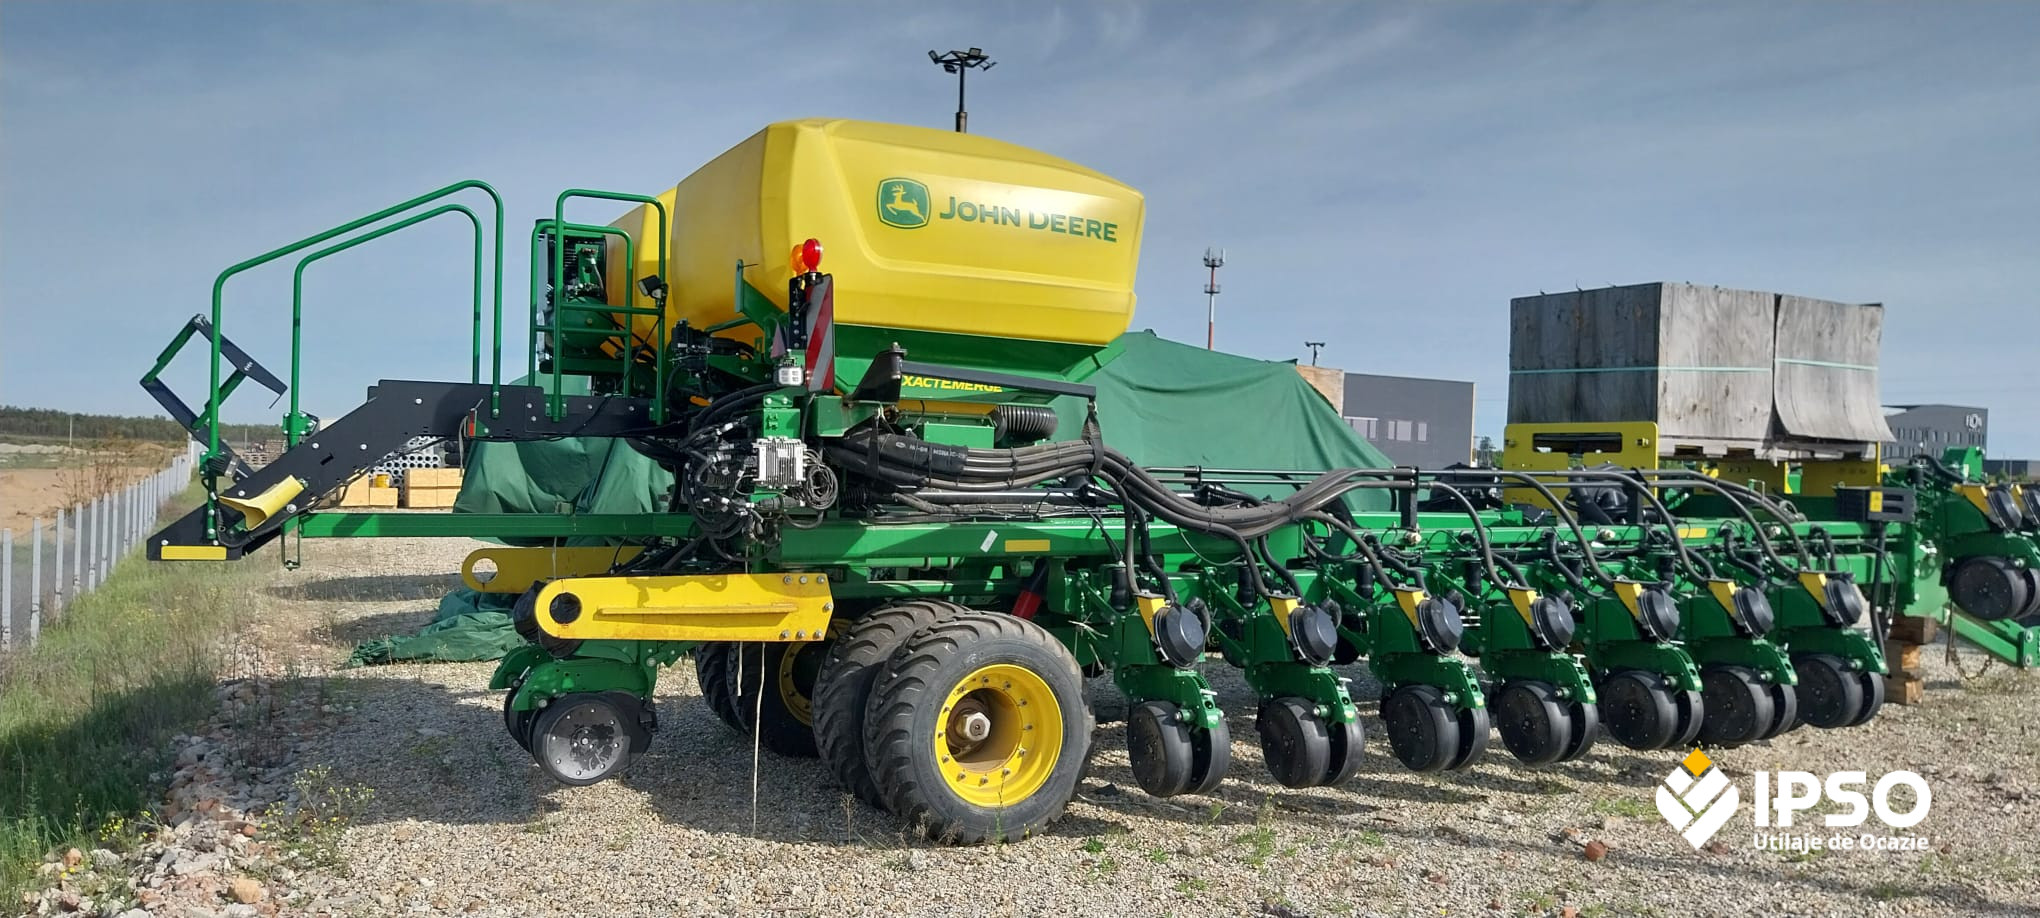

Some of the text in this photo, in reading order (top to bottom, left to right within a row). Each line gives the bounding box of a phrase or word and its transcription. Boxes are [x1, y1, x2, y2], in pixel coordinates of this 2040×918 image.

[940, 196, 1118, 243] JOHN DEERE
[901, 374, 1003, 393] XACTEMERGE
